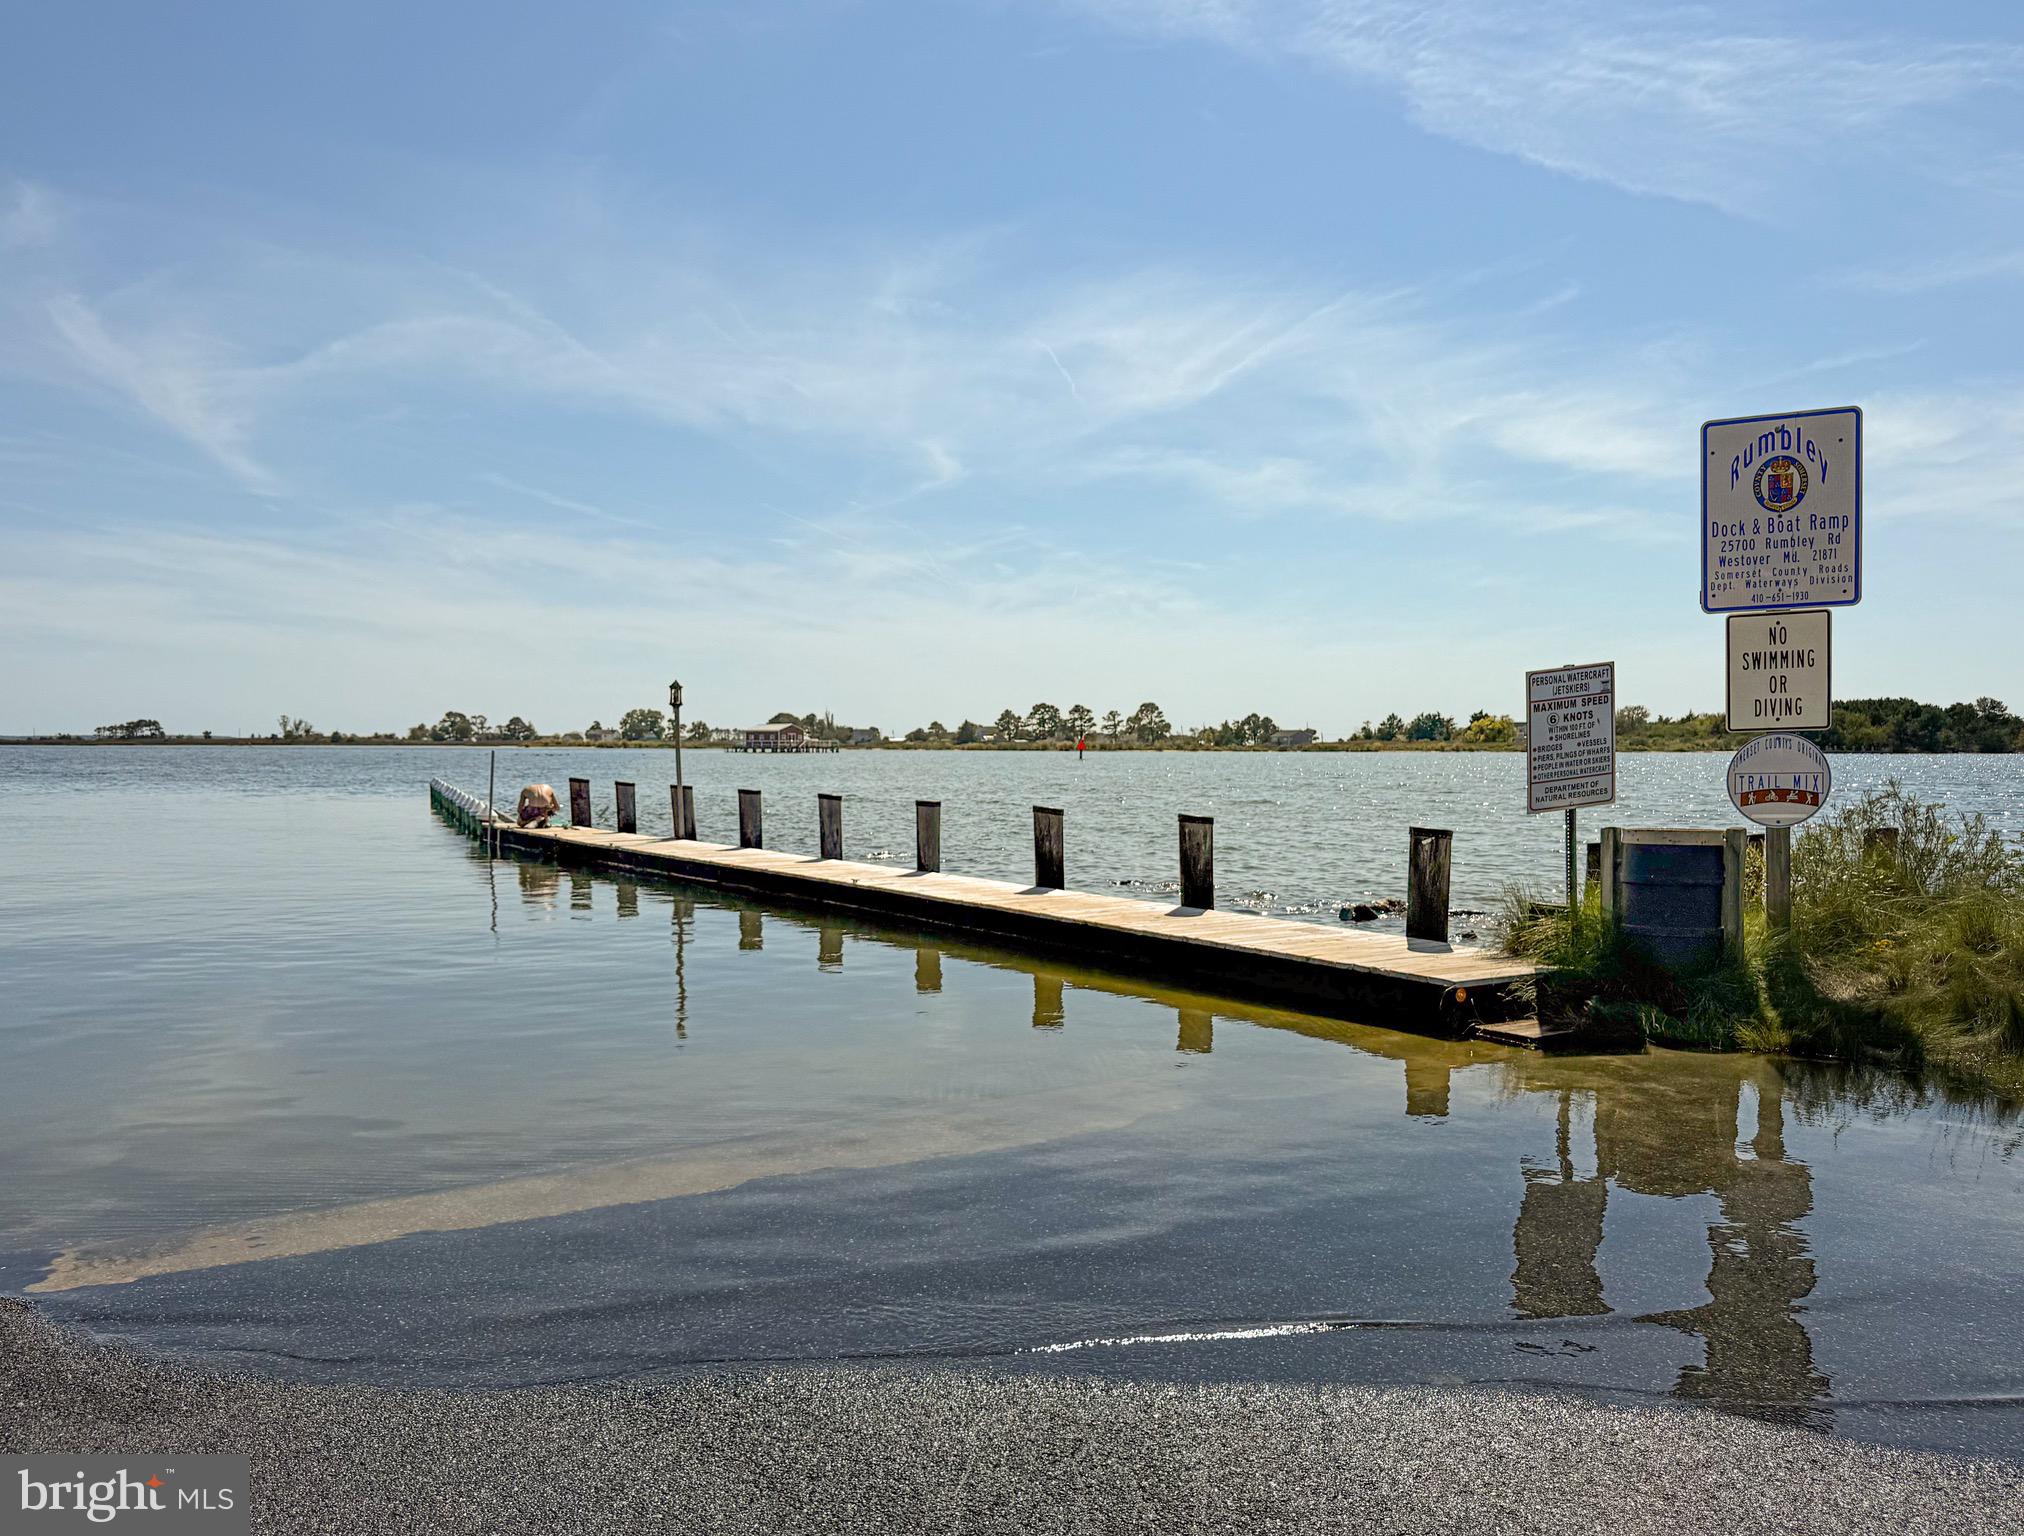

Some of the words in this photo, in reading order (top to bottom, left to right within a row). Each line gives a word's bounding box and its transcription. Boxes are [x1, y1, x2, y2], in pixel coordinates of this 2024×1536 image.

[1731, 424, 1828, 492] Rumbley
[1712, 520, 1746, 538] Dock
[1752, 518, 1760, 534] &
[1768, 516, 1800, 534] Boat
[1810, 514, 1849, 532] Ramp
[1721, 538, 1755, 552] 25700
[1766, 537, 1814, 549] Rumbley
[1828, 533, 1840, 545] Rd
[1719, 555, 1770, 568] Westover
[1784, 552, 1800, 563] Md.
[1812, 549, 1837, 561] 21871
[1715, 569, 1761, 580] Somerset
[1772, 566, 1807, 577] County
[1819, 564, 1848, 574] Roads
[1710, 582, 1735, 592] Dept.
[1745, 578, 1798, 589] Waterways
[1810, 574, 1853, 585] Division
[1751, 591, 1809, 603] 410-651-1930
[1769, 626, 1787, 645] NO
[1742, 649, 1815, 670] SWIMMING
[1532, 675, 1566, 687] PERSONAL
[1567, 668, 1609, 682] WATERCRAFT
[1769, 675, 1787, 693] OR
[1553, 682, 1590, 696] (JETSKIERS)
[1534, 699, 1576, 713] MAXIMUM
[1581, 695, 1609, 707] SPEED
[1754, 698, 1802, 717] DIVING
[1550, 715, 1556, 724] 6
[1564, 711, 1593, 722] KNOTS
[1548, 725, 1568, 734] WITHIN
[1555, 731, 1590, 741] SHORELINES
[1538, 743, 1562, 753] BRIDGES
[1582, 738, 1607, 747] VESSELS
[1556, 751, 1577, 760] PILINGS
[1587, 746, 1610, 755] WHARFS
[1538, 762, 1558, 771] PEOPLE
[1565, 759, 1582, 768] WATER
[1592, 756, 1610, 764] SKIERS
[1538, 772, 1553, 780] OTHER
[1554, 769, 1578, 778] PERSONAL
[1580, 765, 1610, 774] WATERCRAFT
[1545, 782, 1589, 794] DEPARTMENT
[1739, 775, 1780, 792] TRAIL
[1793, 775, 1818, 791] MIX
[1536, 794, 1567, 803] NATURAL
[1568, 788, 1608, 799] RESOURCES
